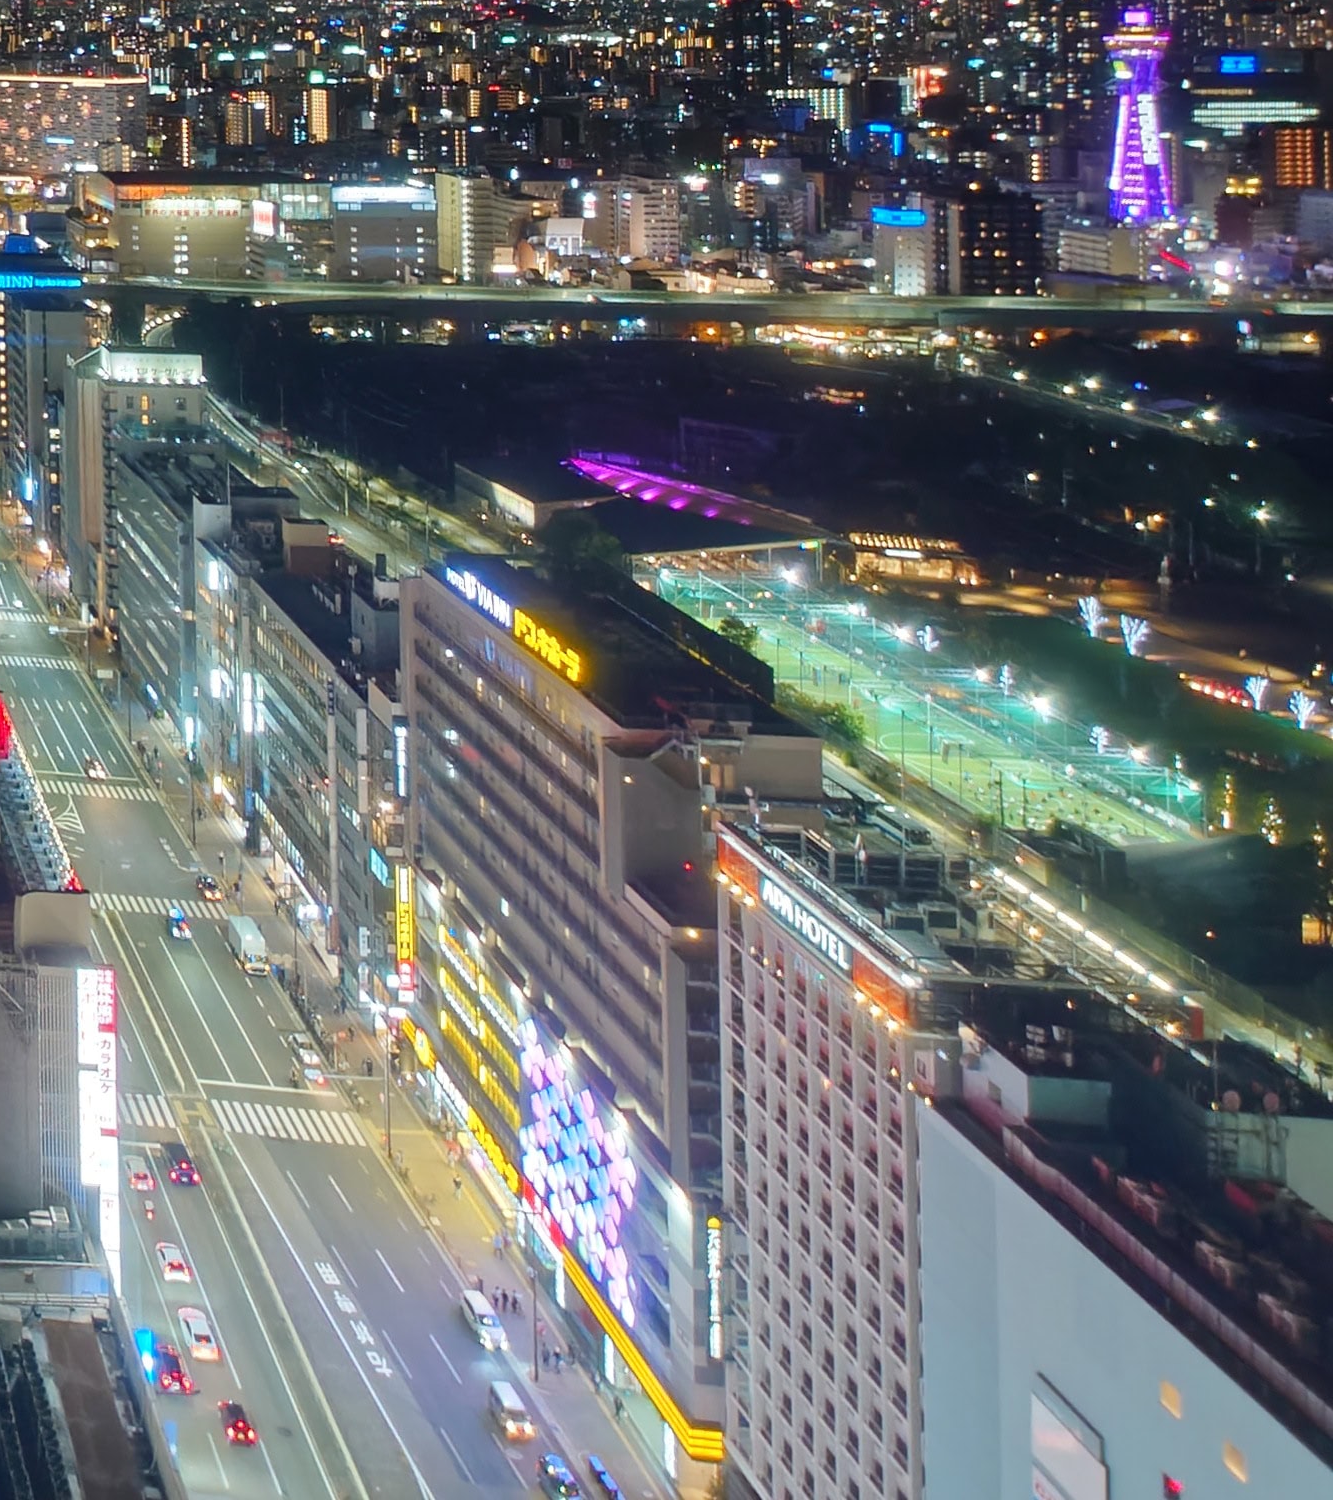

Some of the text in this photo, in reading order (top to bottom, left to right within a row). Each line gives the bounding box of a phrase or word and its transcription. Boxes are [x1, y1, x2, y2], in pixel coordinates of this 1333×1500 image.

[762, 878, 850, 971] APA HOTEL
[100, 1039, 113, 1094] カラオケ
